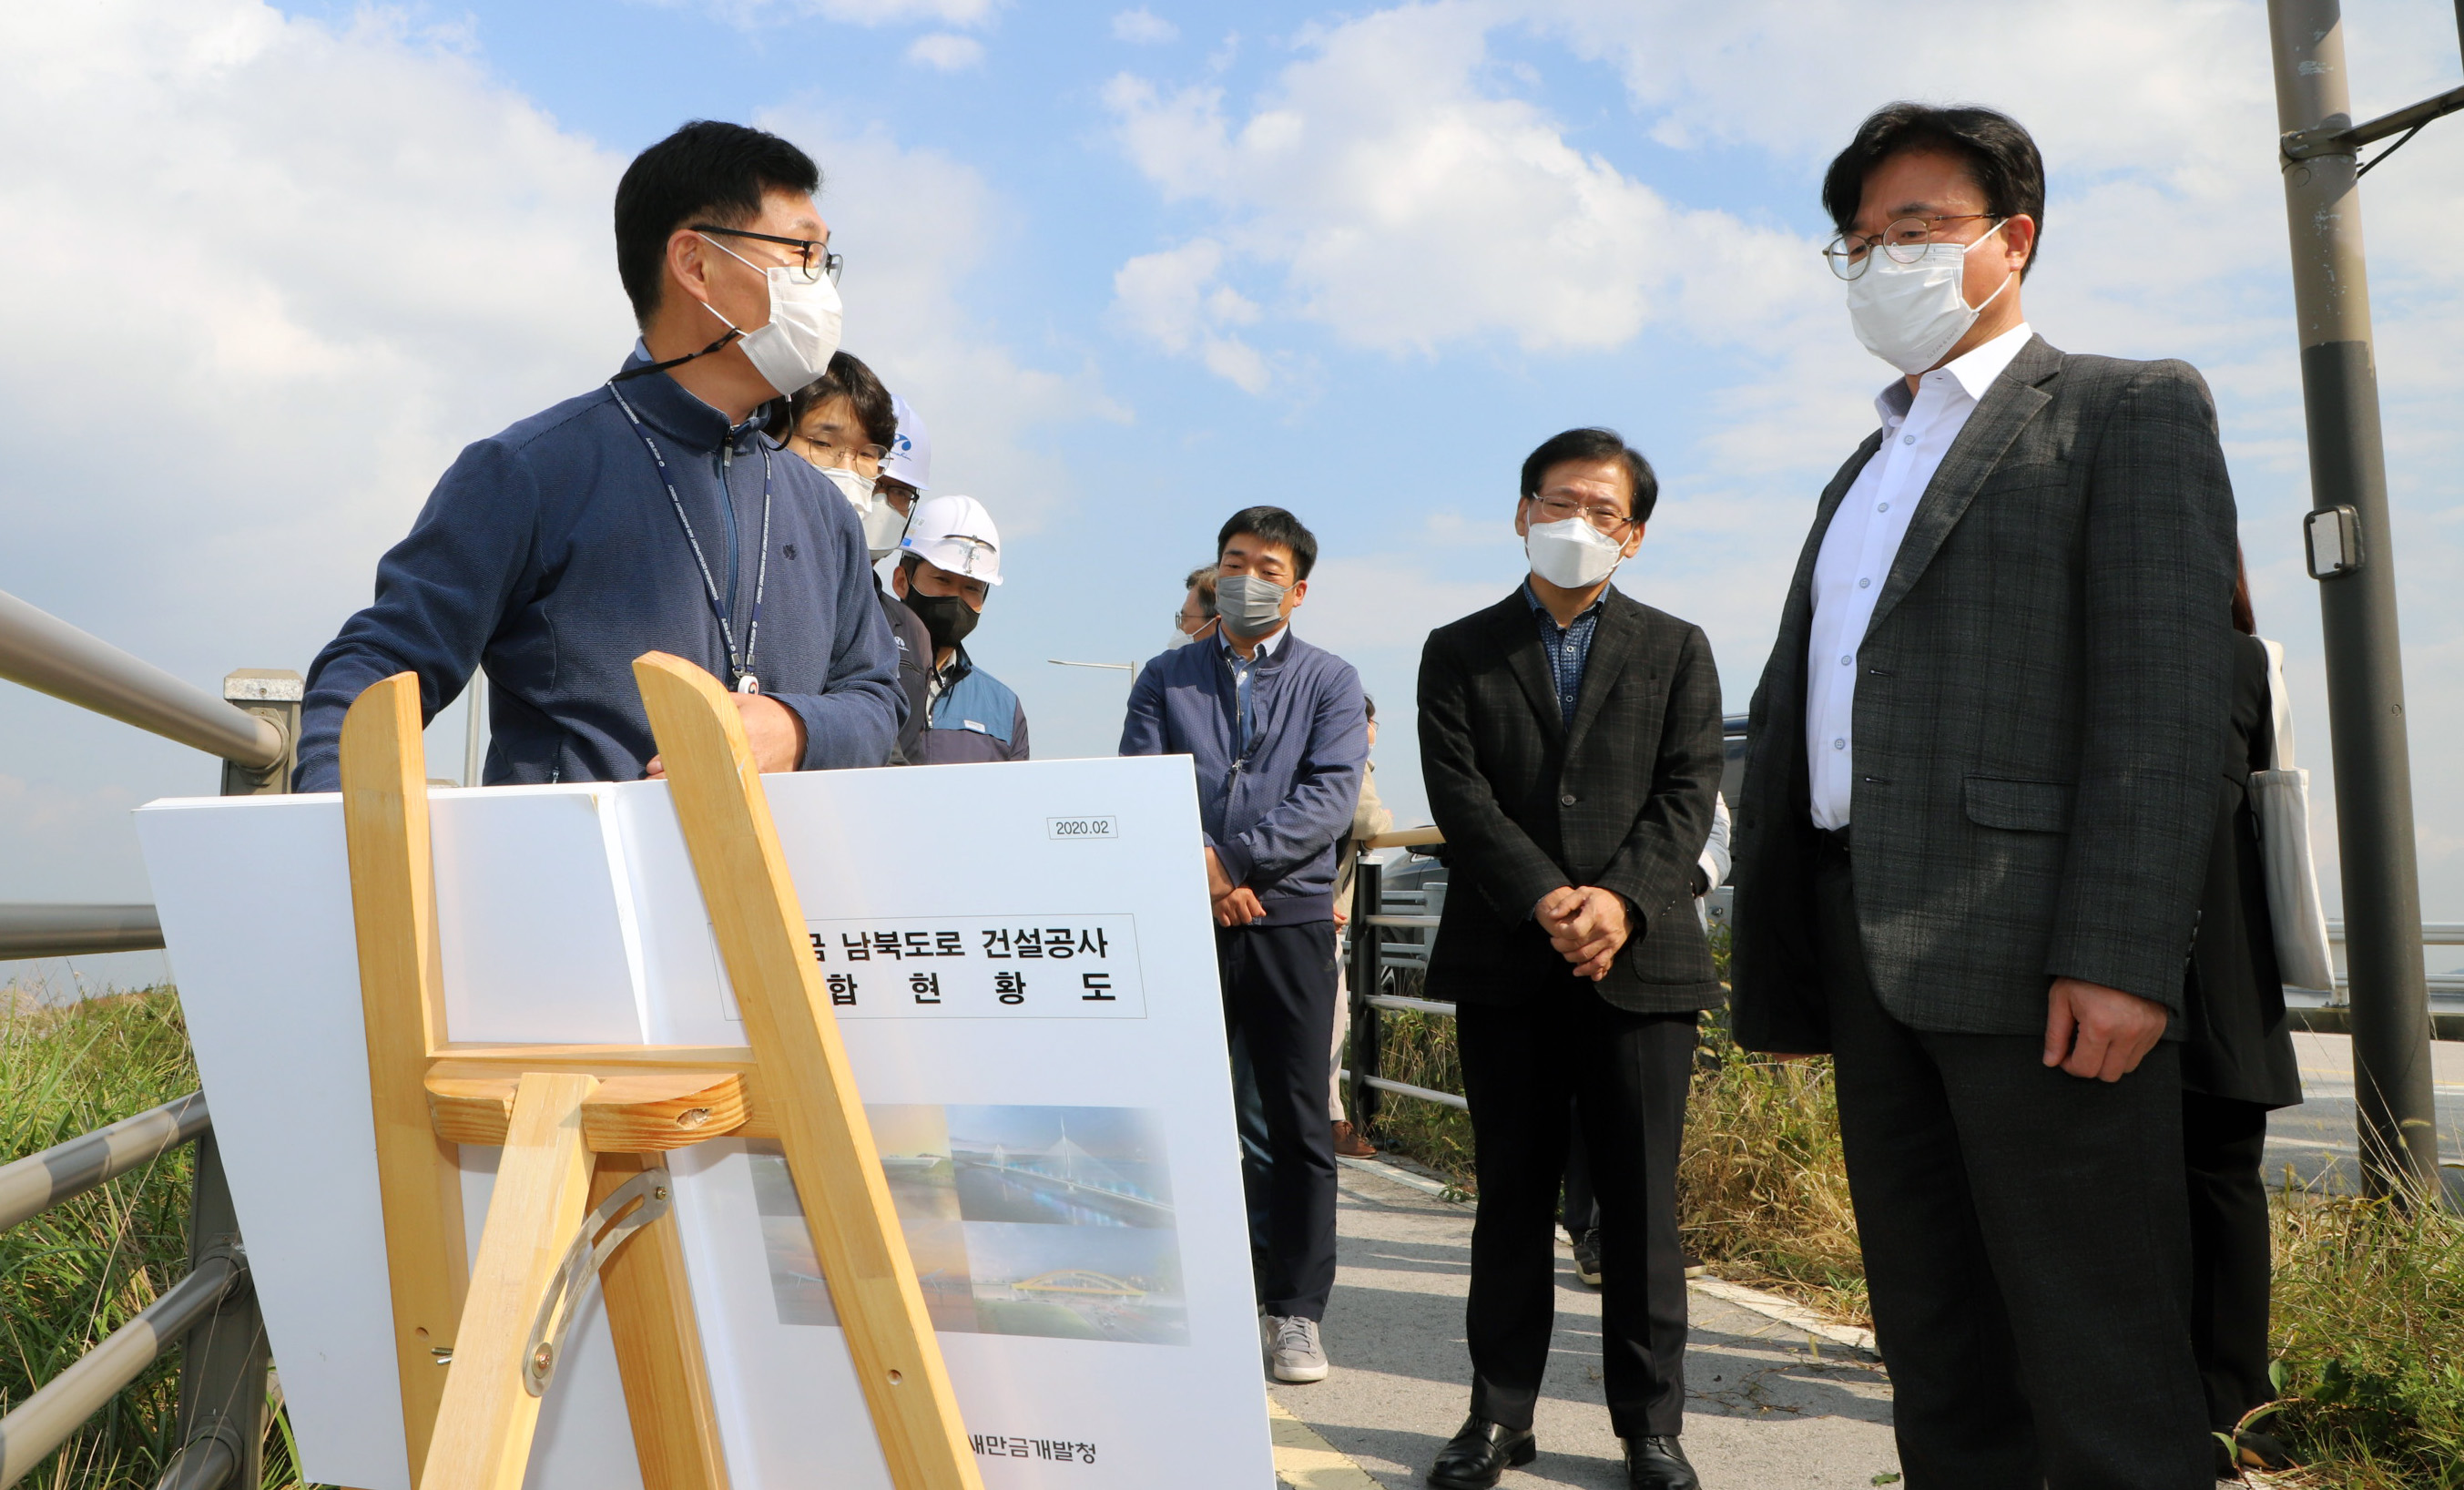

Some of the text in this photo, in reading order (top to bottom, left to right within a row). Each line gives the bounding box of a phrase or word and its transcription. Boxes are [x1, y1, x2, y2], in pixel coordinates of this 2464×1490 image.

[667, 484, 678, 502] AGENCY
[676, 501, 690, 528] INVESTMENT
[690, 537, 708, 569] DEVELOPMENT
[1056, 821, 1109, 835] 2020.02
[841, 931, 965, 961] 남북도로
[982, 927, 1108, 958] 건설공사
[827, 971, 1116, 1005] 합 현 황 도
[968, 1434, 1096, 1464] 새만금개발청
